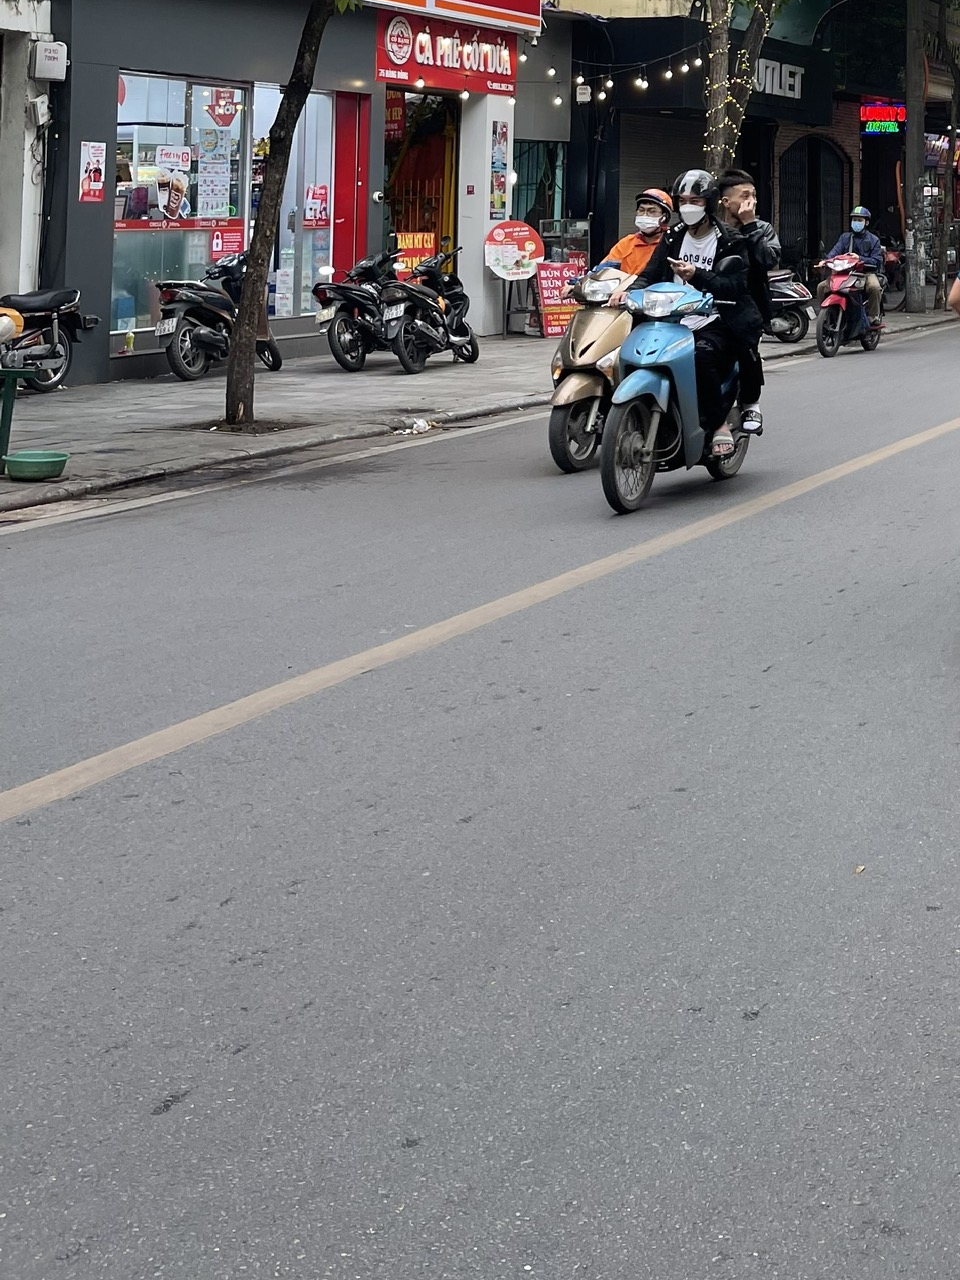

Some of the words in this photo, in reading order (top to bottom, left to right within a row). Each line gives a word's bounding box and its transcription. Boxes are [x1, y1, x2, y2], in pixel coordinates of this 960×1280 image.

[754, 58, 805, 99] UTLET
[540, 268, 560, 278] BÚN
[562, 267, 576, 278] ỐC
[540, 278, 562, 288] BÚN
